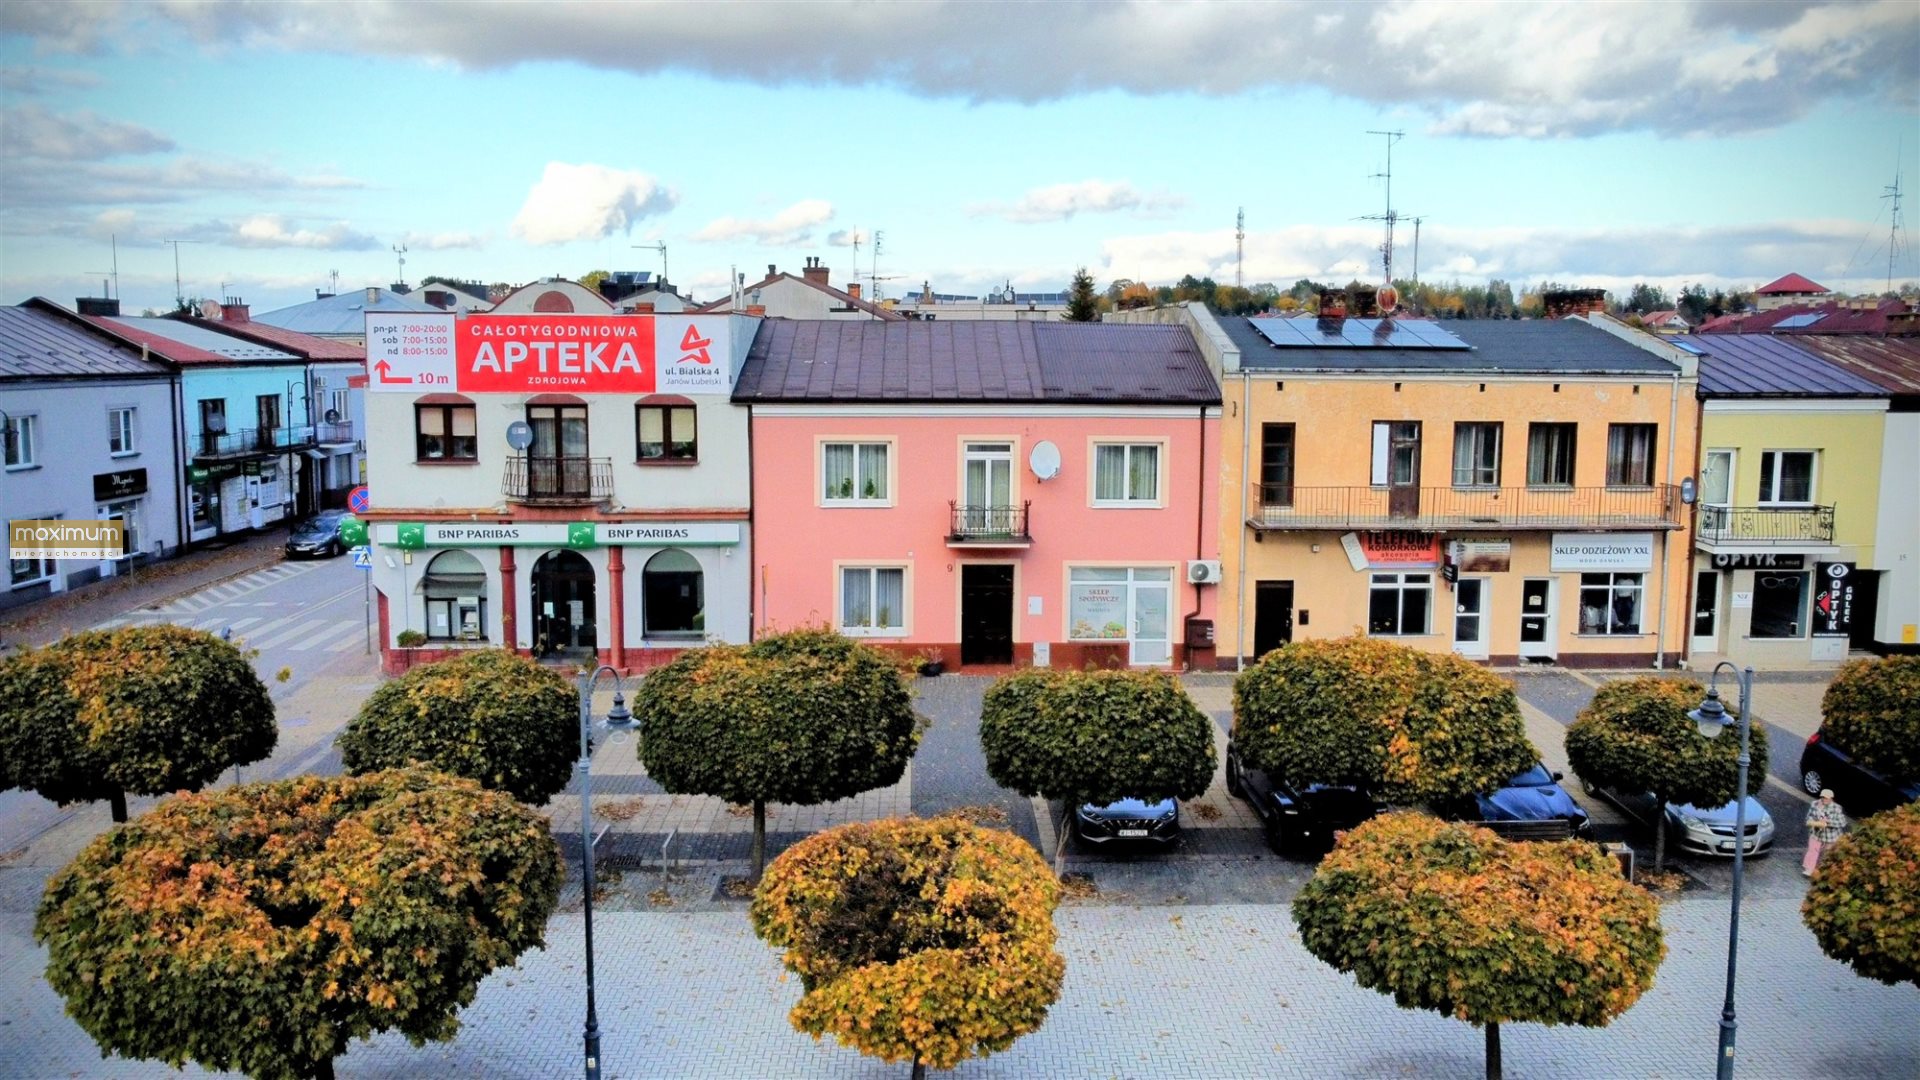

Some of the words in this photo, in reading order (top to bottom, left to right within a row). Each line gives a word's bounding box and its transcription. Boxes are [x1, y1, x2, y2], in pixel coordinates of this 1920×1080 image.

[373, 325, 398, 334] pn-pt
[402, 325, 448, 333] 7:00-20:00
[471, 325, 638, 337] CAŁOTYGODNIOWA
[382, 336, 398, 344] sob
[402, 336, 448, 344] 7:00-15:00
[387, 347, 399, 355] nd
[402, 347, 448, 355] 8:00-15:00
[471, 341, 642, 373] APTEKA
[665, 367, 677, 375] ul.
[679, 367, 712, 375] Bialska
[714, 367, 720, 375] 4
[418, 372, 434, 384] 10
[437, 375, 449, 384] m
[527, 377, 587, 385] ZDROJOWA
[438, 529, 464, 539] BNP
[466, 529, 520, 539] PARIBAS
[608, 529, 634, 539] BNP
[636, 528, 689, 538] PARIBAS
[1554, 546, 1581, 555] SKLEP
[1581, 545, 1632, 555] ODZIEŻOWY
[1634, 546, 1649, 555] XXL
[1716, 553, 1777, 567] OPTYK
[946, 563, 953, 573] 9
[1828, 579, 1841, 630] OPTYK
[1843, 586, 1853, 623] GOLEC
